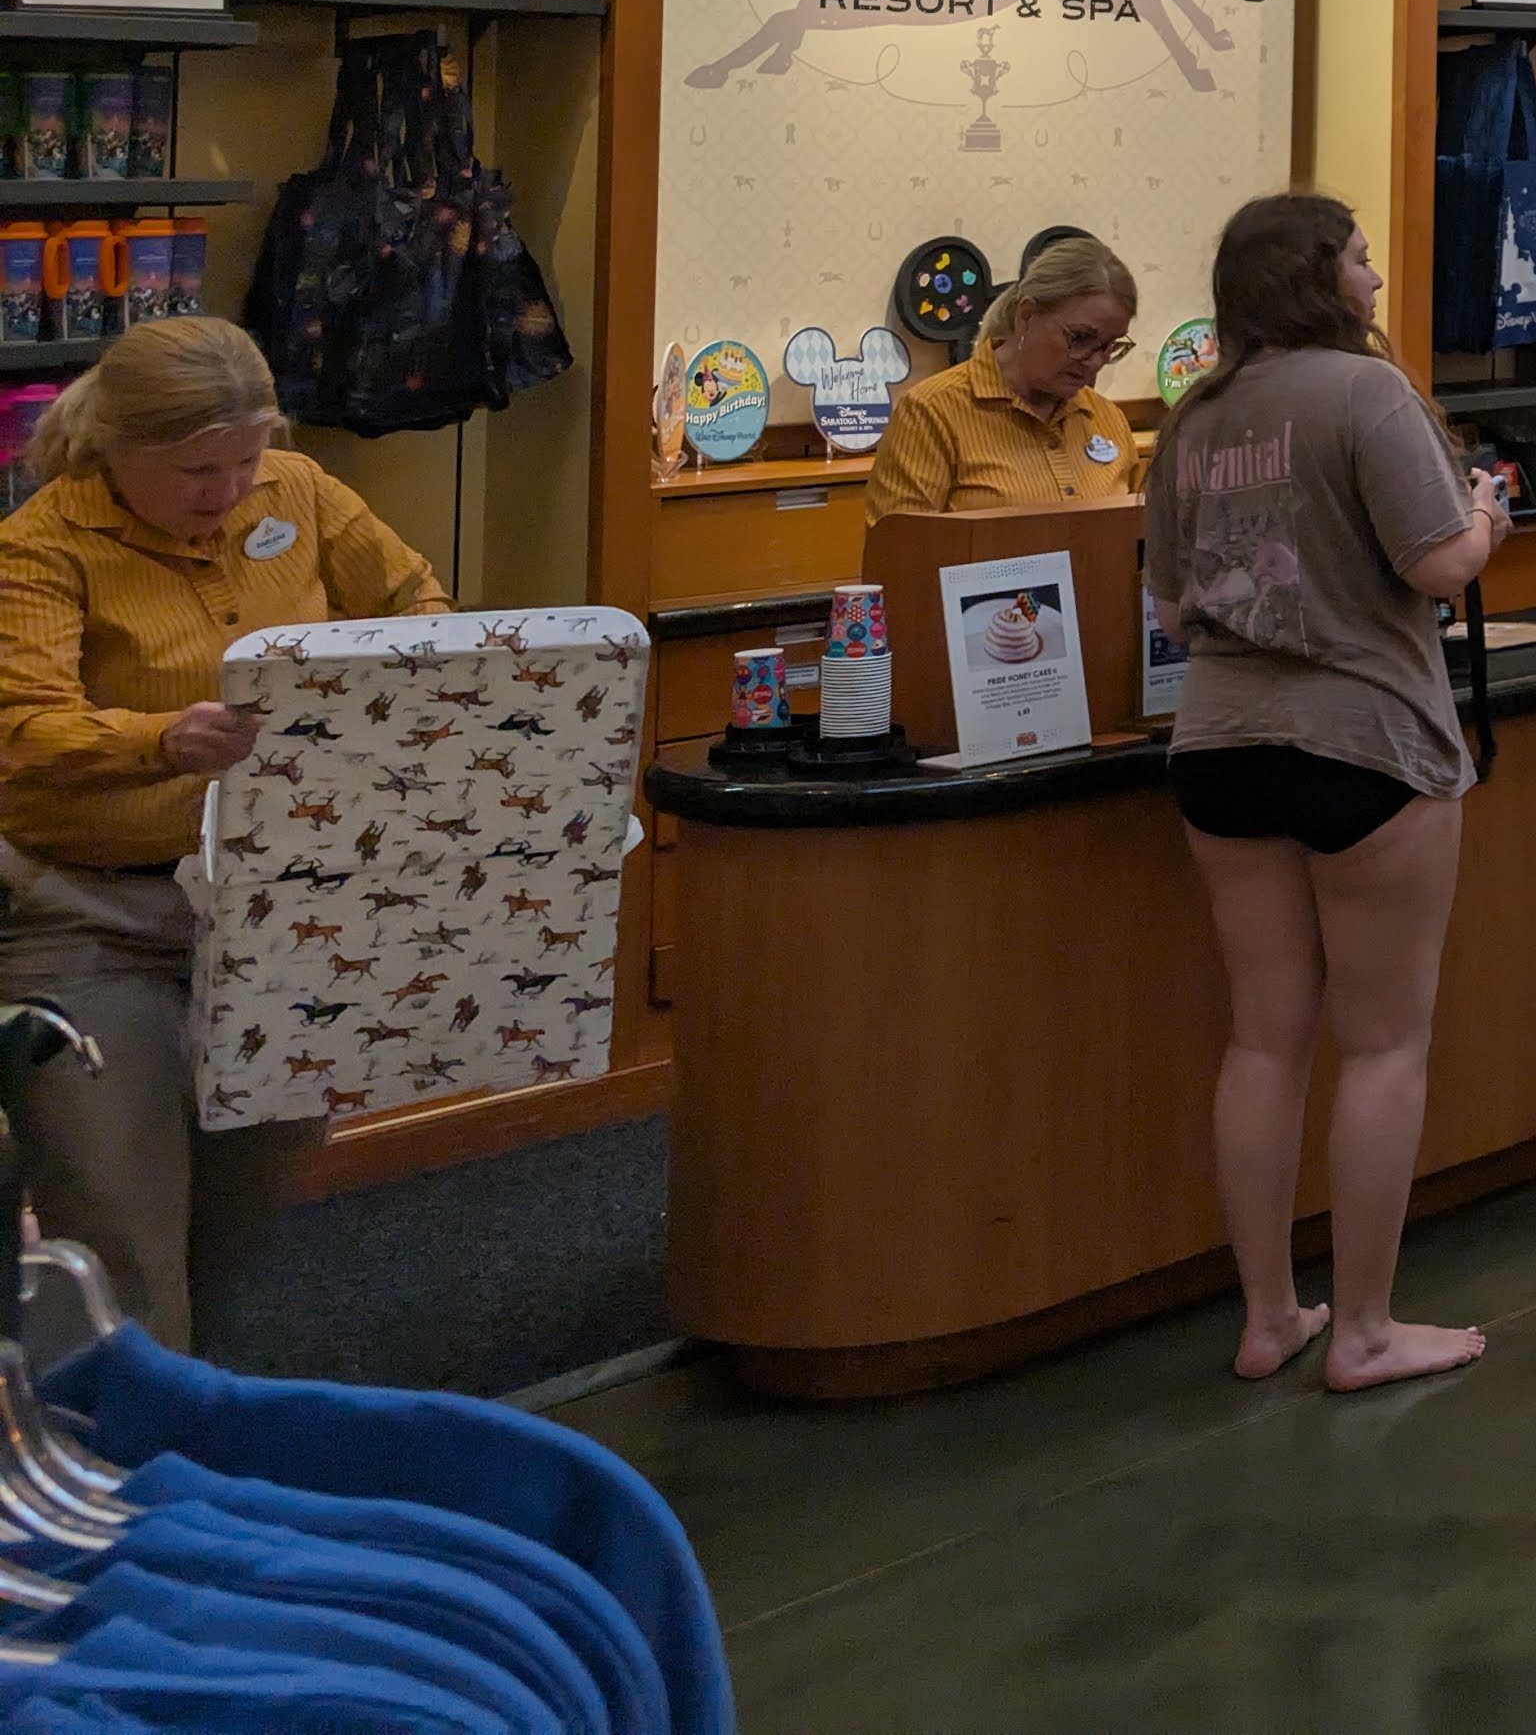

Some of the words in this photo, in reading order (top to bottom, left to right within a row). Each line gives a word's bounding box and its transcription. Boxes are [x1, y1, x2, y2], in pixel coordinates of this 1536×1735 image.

[821, 364, 864, 390] Welcome
[1164, 377, 1181, 387] I'm
[851, 381, 877, 401] Home
[686, 409, 718, 426] Happy
[719, 394, 766, 416] Birthday!
[820, 416, 858, 426] SARATOGA
[987, 675, 1007, 685] PRIDE
[1033, 668, 1052, 678] CAKE
